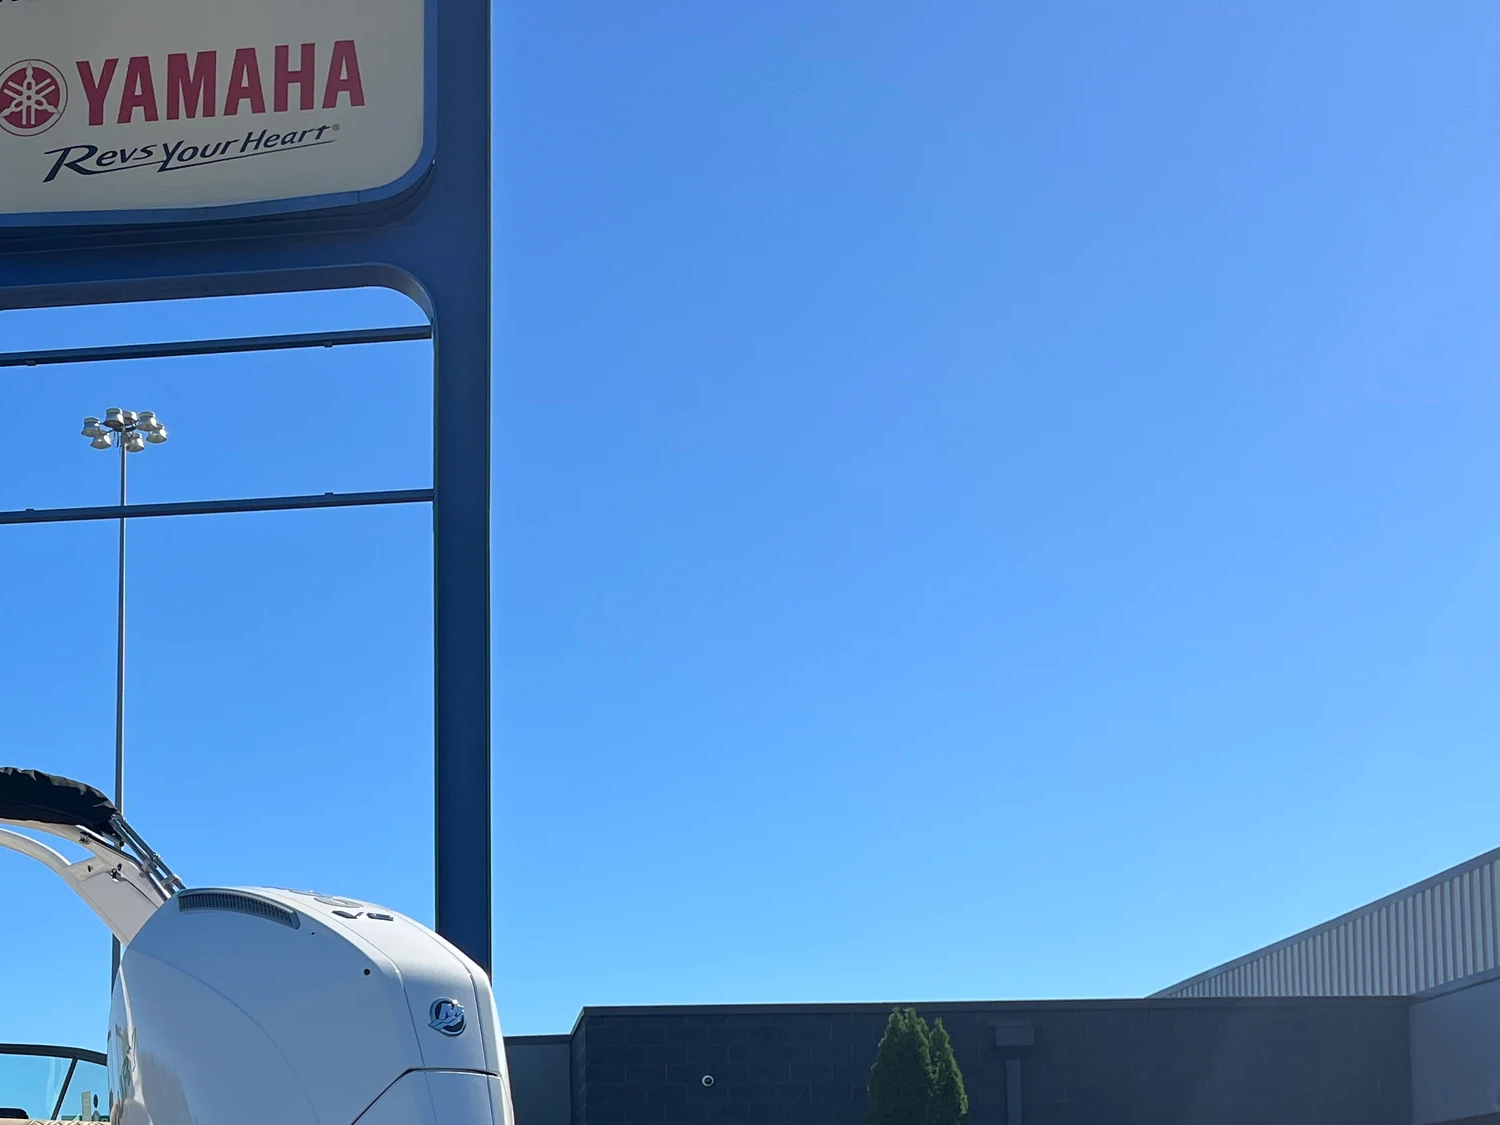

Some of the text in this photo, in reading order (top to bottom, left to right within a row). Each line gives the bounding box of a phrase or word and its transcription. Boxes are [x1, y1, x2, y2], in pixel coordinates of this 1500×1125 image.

[75, 39, 366, 126] YAMAHA
[43, 125, 332, 183] Revs Your Heart
